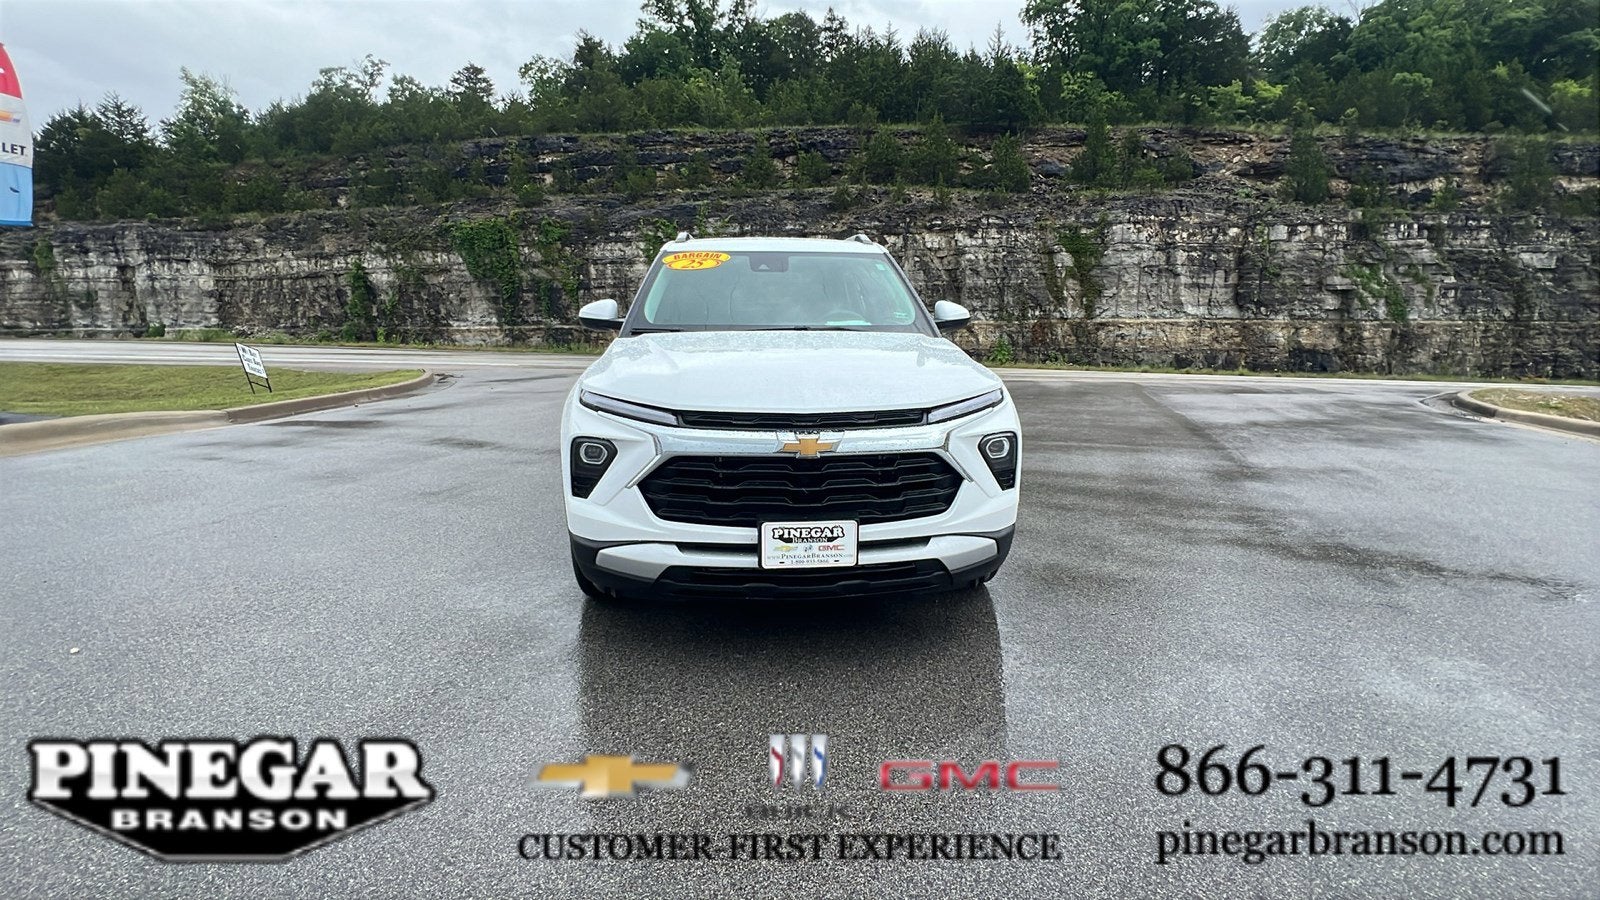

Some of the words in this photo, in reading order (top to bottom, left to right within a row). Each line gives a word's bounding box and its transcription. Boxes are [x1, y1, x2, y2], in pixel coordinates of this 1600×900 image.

[674, 252, 721, 260] BARGAIN
[773, 527, 844, 539] PINEGAR
[818, 544, 845, 552] GMC
